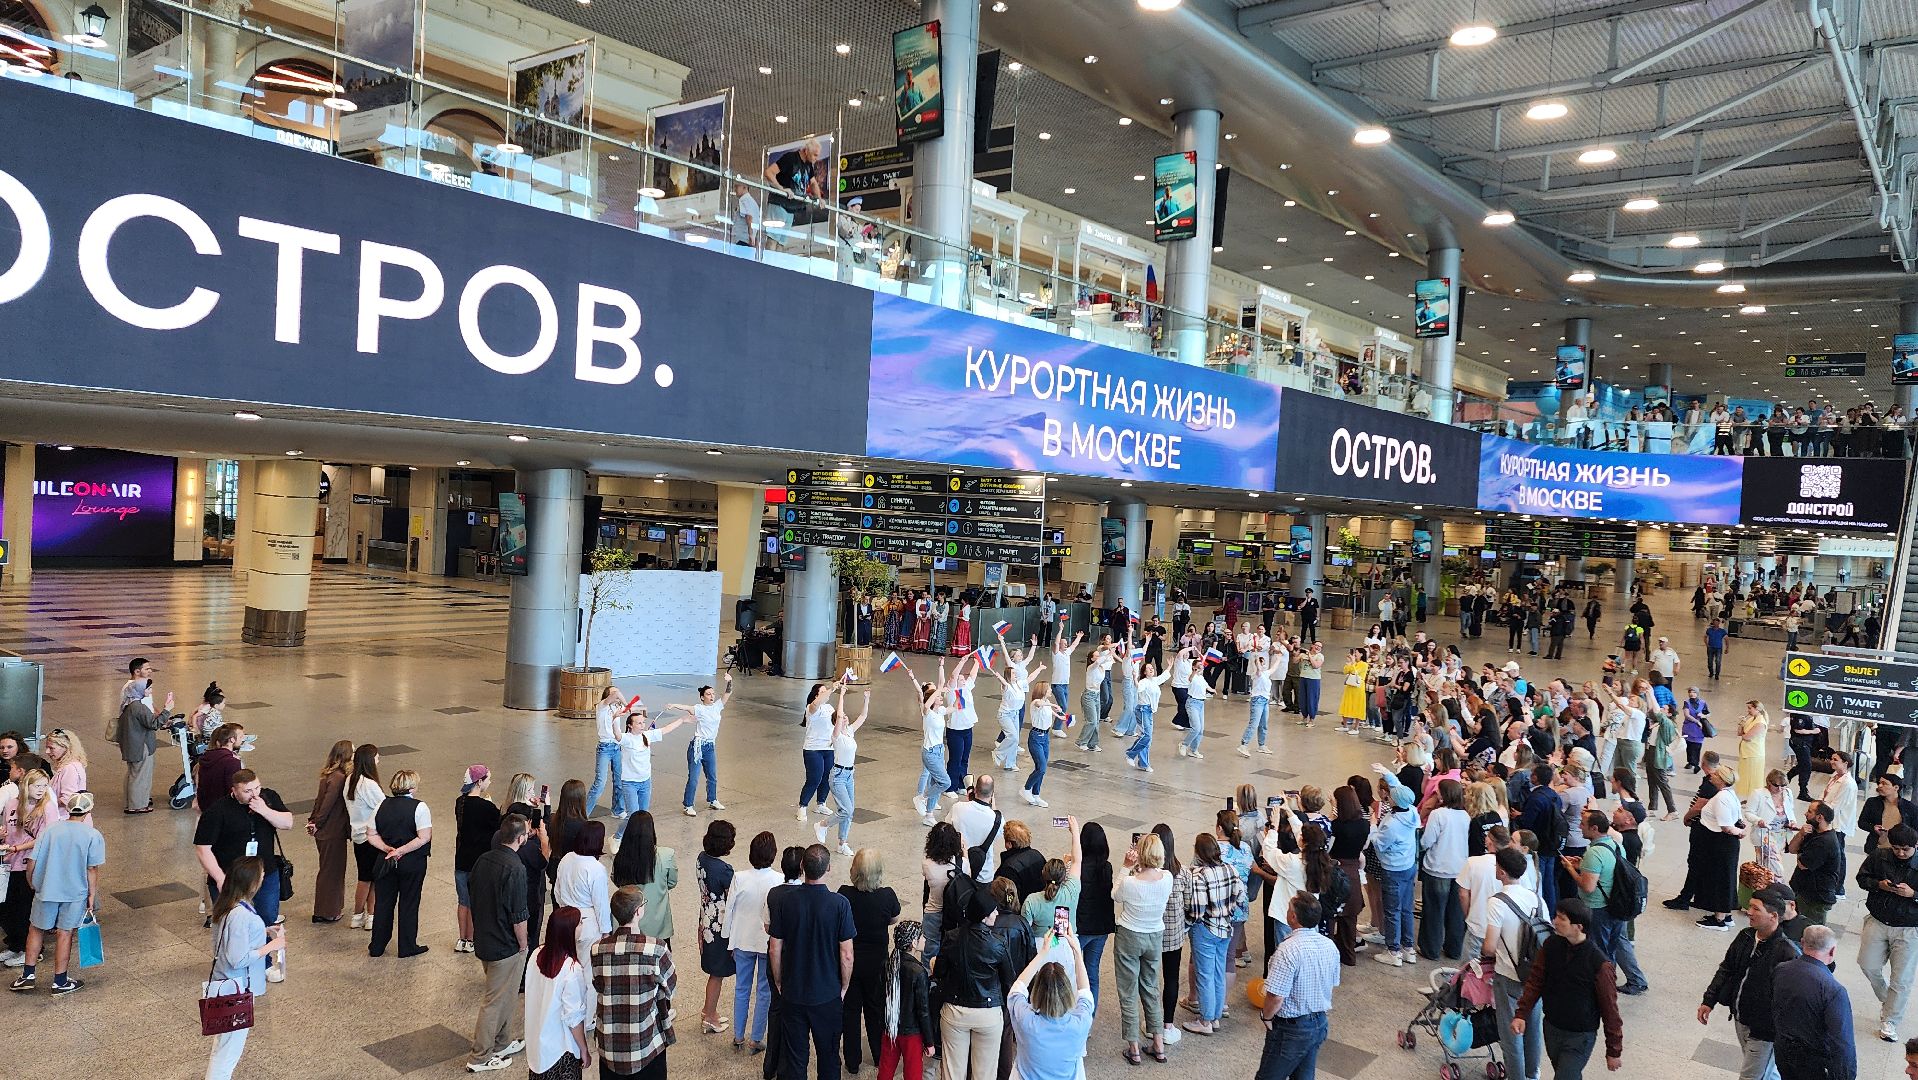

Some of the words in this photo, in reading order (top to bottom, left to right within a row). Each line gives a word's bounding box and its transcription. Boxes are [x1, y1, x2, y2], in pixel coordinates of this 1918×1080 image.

[965, 346, 1146, 416] КУРОРТНАЯ
[1152, 383, 1236, 430] ЖИЗНЬ
[1042, 418, 1061, 457] В
[1071, 421, 1182, 470] МОСКВЕ
[1331, 428, 1436, 484] ОСТРОВ.
[1500, 454, 1570, 482] КУРОРТНАЯ
[1574, 464, 1671, 487] ЖИЗНЬ
[72, 499, 140, 520] Lounge
[1519, 486, 1525, 504] В
[1525, 487, 1603, 511] МОСКВЕ
[1786, 502, 1854, 516] ДОНСТРОЙ
[1844, 665, 1880, 676] ВЫЛЕТ
[1844, 677, 1881, 685] DEPARTURES
[1843, 697, 1882, 709] ТУАЛЕТ
